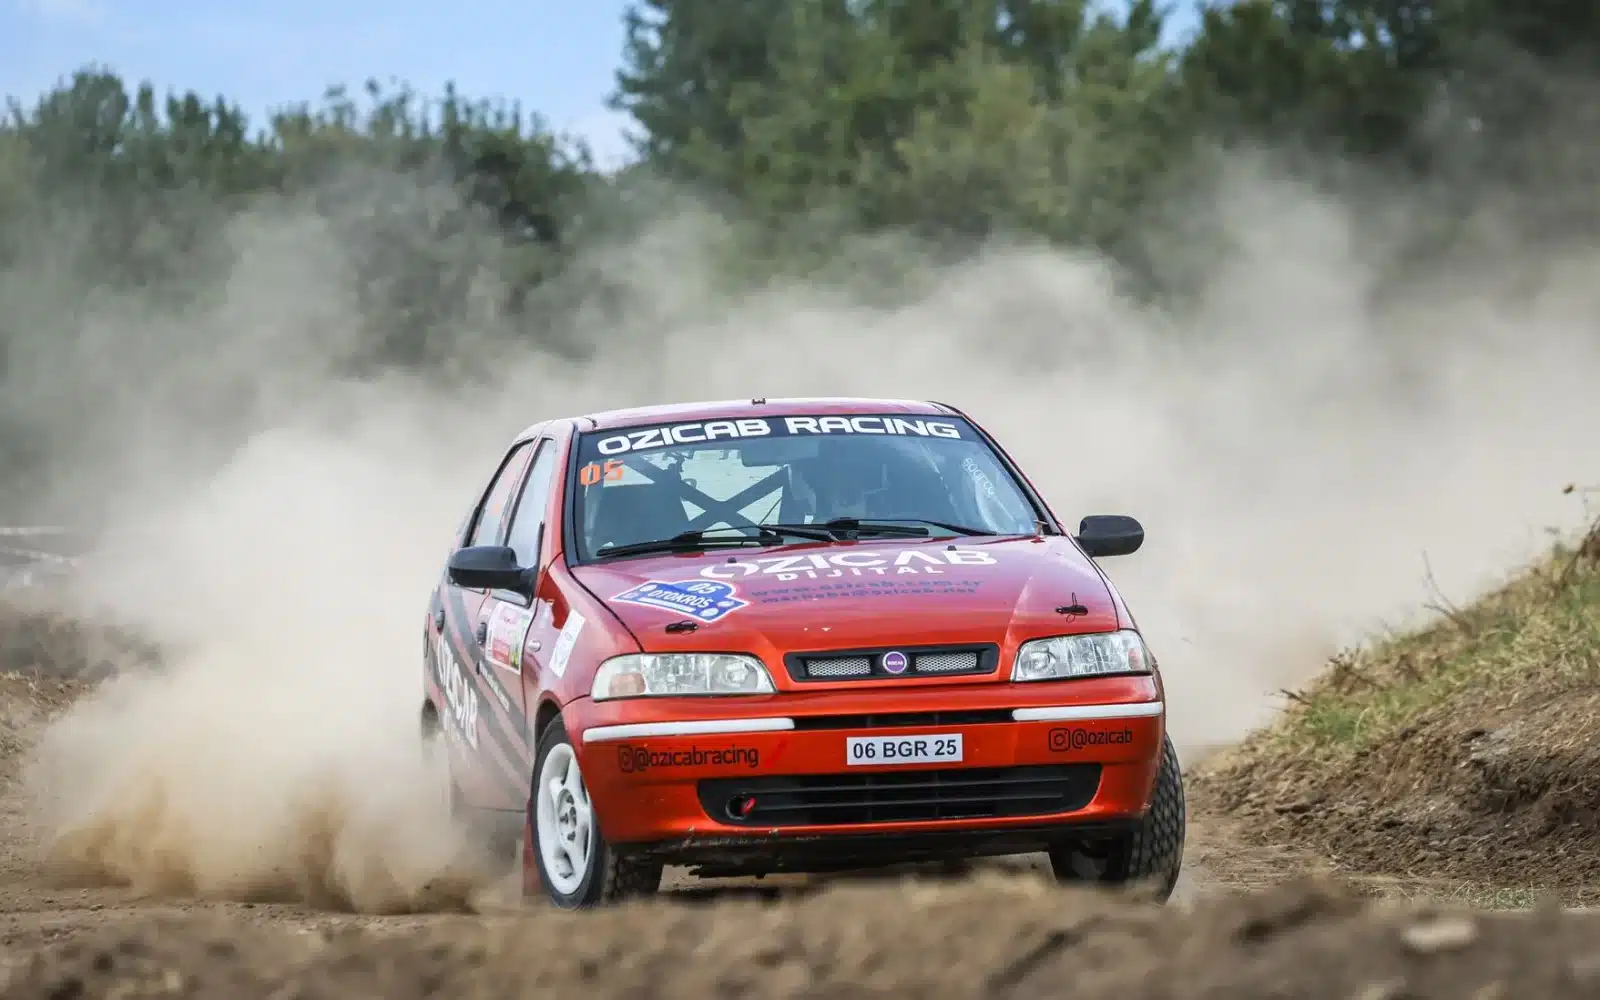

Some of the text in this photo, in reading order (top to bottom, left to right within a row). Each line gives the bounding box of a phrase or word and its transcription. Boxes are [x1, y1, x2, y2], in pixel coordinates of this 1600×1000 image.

[597, 417, 961, 455] OZICAB RACING
[580, 458, 625, 486] 05
[700, 550, 998, 578] OZICAB
[776, 566, 945, 581] DIJITAL
[647, 589, 714, 608] OTOKROS
[687, 583, 725, 594] 05
[853, 739, 957, 759] 06 BGR 25
[1072, 726, 1133, 749] @ozicab
[634, 744, 759, 771] @ozicabracing
